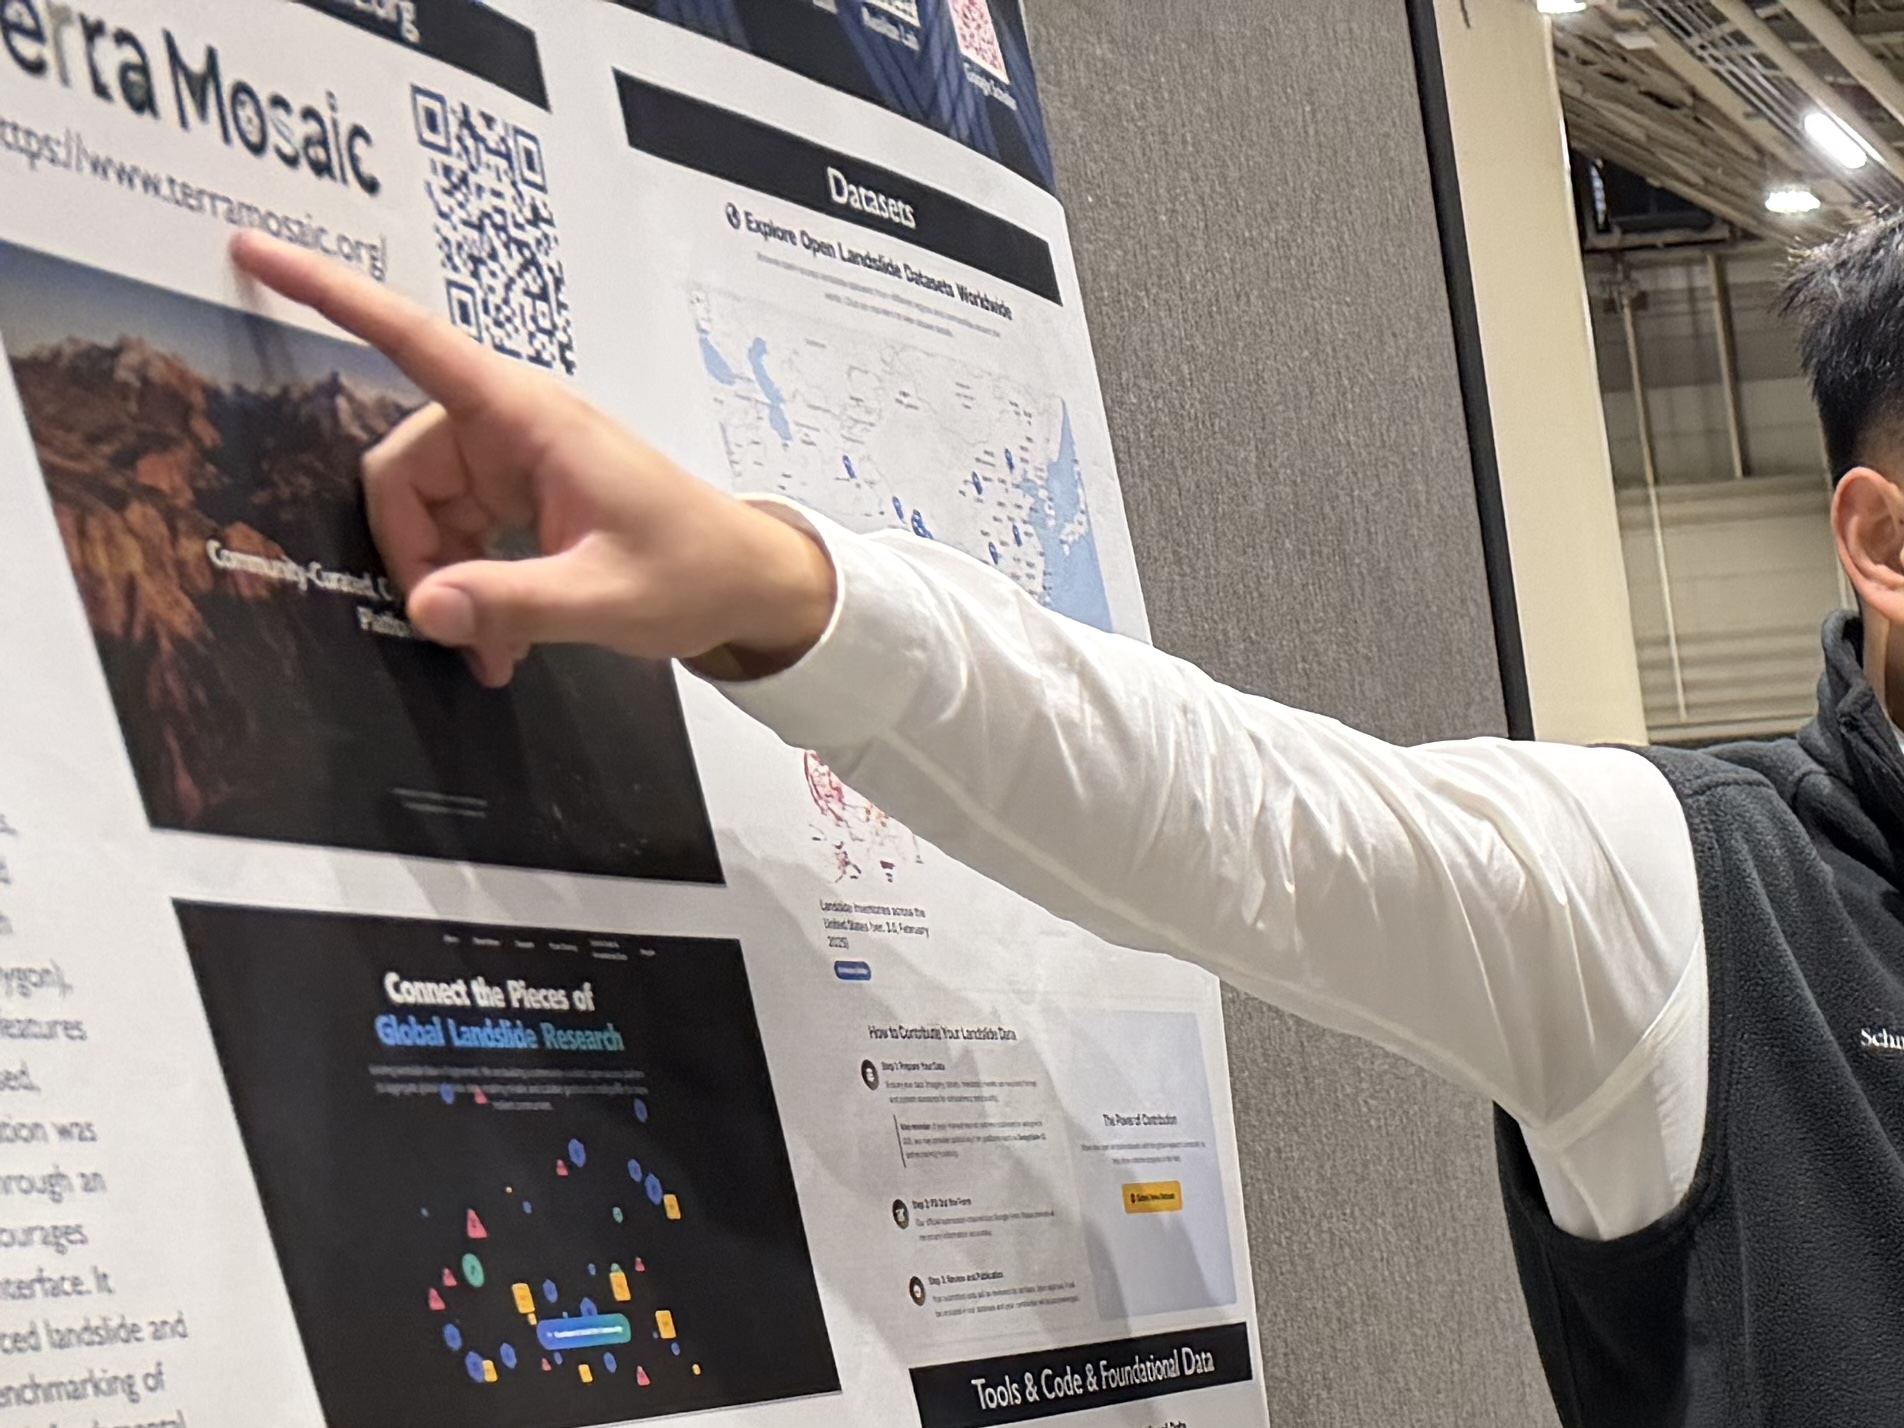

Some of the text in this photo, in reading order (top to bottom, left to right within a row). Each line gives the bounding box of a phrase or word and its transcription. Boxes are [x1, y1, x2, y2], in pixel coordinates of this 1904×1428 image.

[0, 0, 381, 196] erra Mosaic
[0, 117, 389, 282] ttps://www.terramosaic.org/
[827, 166, 916, 229] Datasets
[744, 210, 1013, 320] Explore Open Landslide Datasets Worldwide
[384, 971, 595, 1011] Connect the Pieces of
[0, 1018, 87, 1040] eatures
[374, 1013, 625, 1051] Global Landslide Research
[52, 1121, 97, 1142] was
[0, 1164, 107, 1204] rough an
[0, 1224, 89, 1256] ourages
[93, 1265, 115, 1294] It
[0, 1309, 188, 1353] ced landslide and
[143, 1361, 164, 1392] of
[971, 1347, 1216, 1410] Tools & Code & Foundational Data
